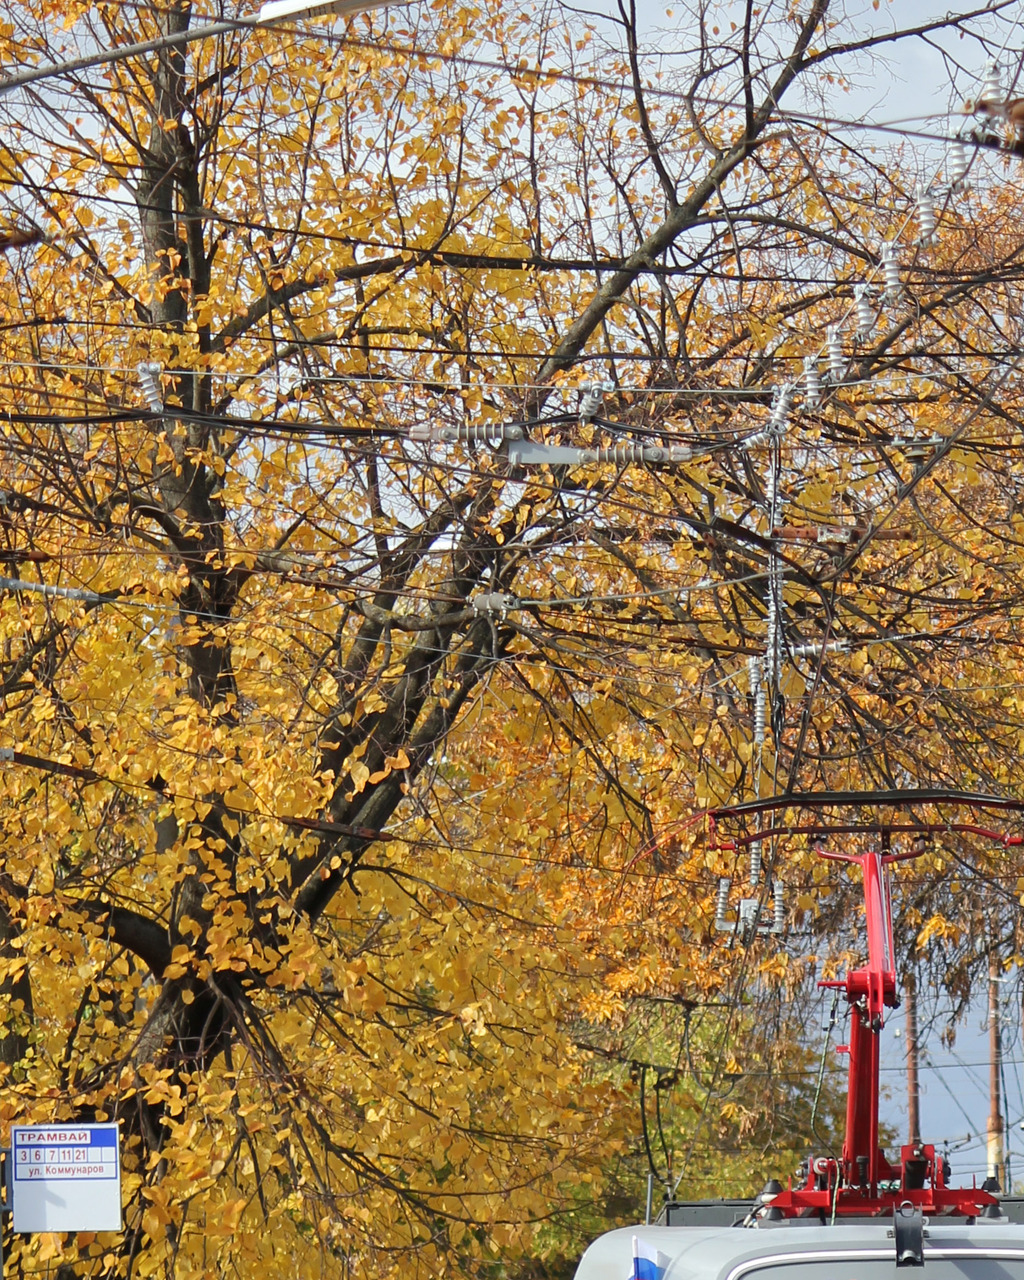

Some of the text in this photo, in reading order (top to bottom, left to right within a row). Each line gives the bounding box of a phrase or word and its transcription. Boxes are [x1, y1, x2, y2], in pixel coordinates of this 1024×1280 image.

[19, 1131, 88, 1142] ТРАМВАЙ
[20, 1149, 86, 1161] 3 6 7 11 21
[28, 1165, 104, 1178] ул. Коммунаров
